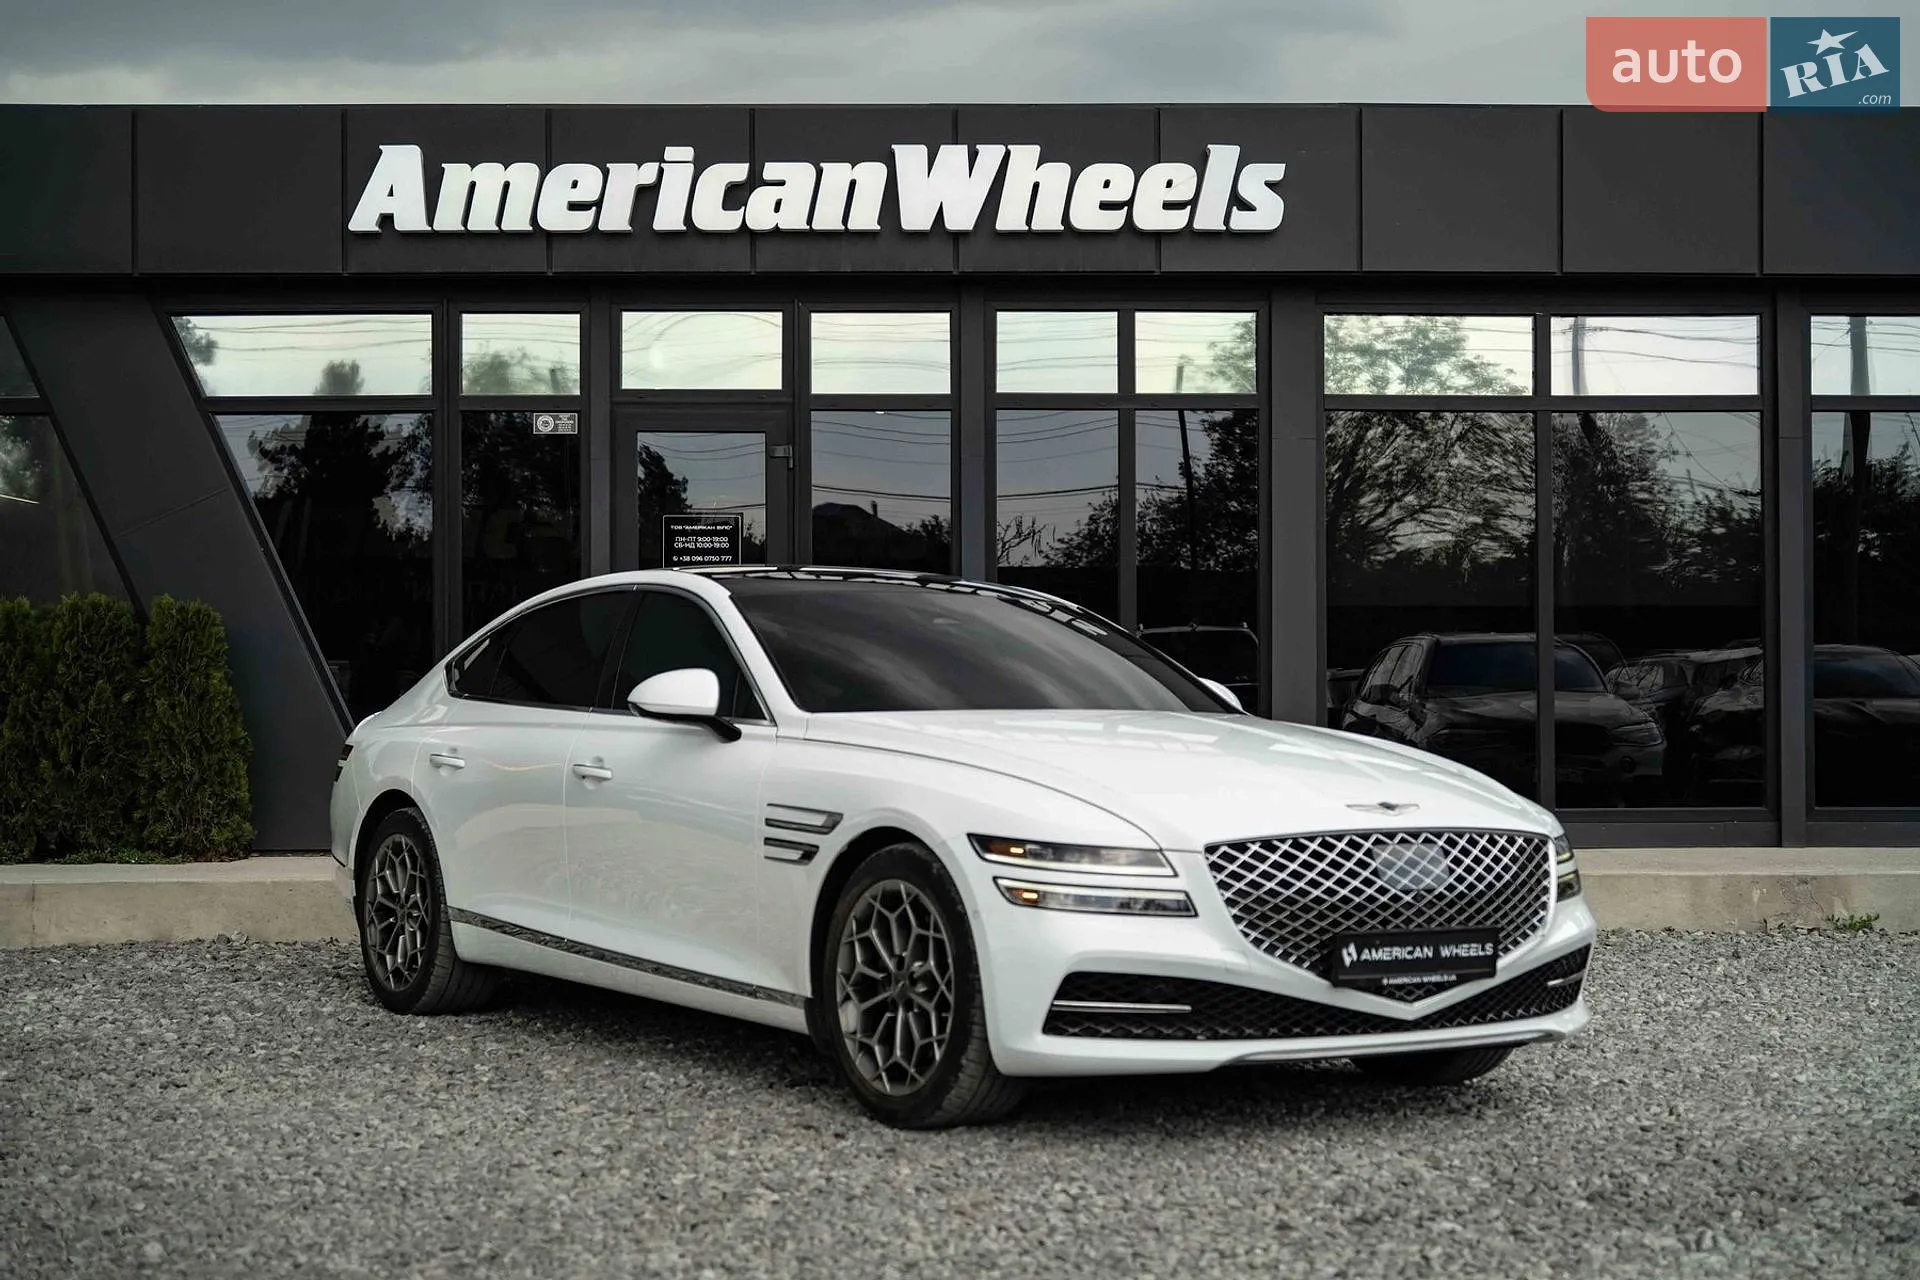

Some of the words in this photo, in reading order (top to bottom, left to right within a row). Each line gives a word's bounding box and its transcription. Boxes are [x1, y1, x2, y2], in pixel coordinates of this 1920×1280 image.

[347, 143, 1287, 235] AmericanWheels
[1359, 945, 1434, 962] AMERICAN
[1439, 942, 1495, 958] WHEELS
